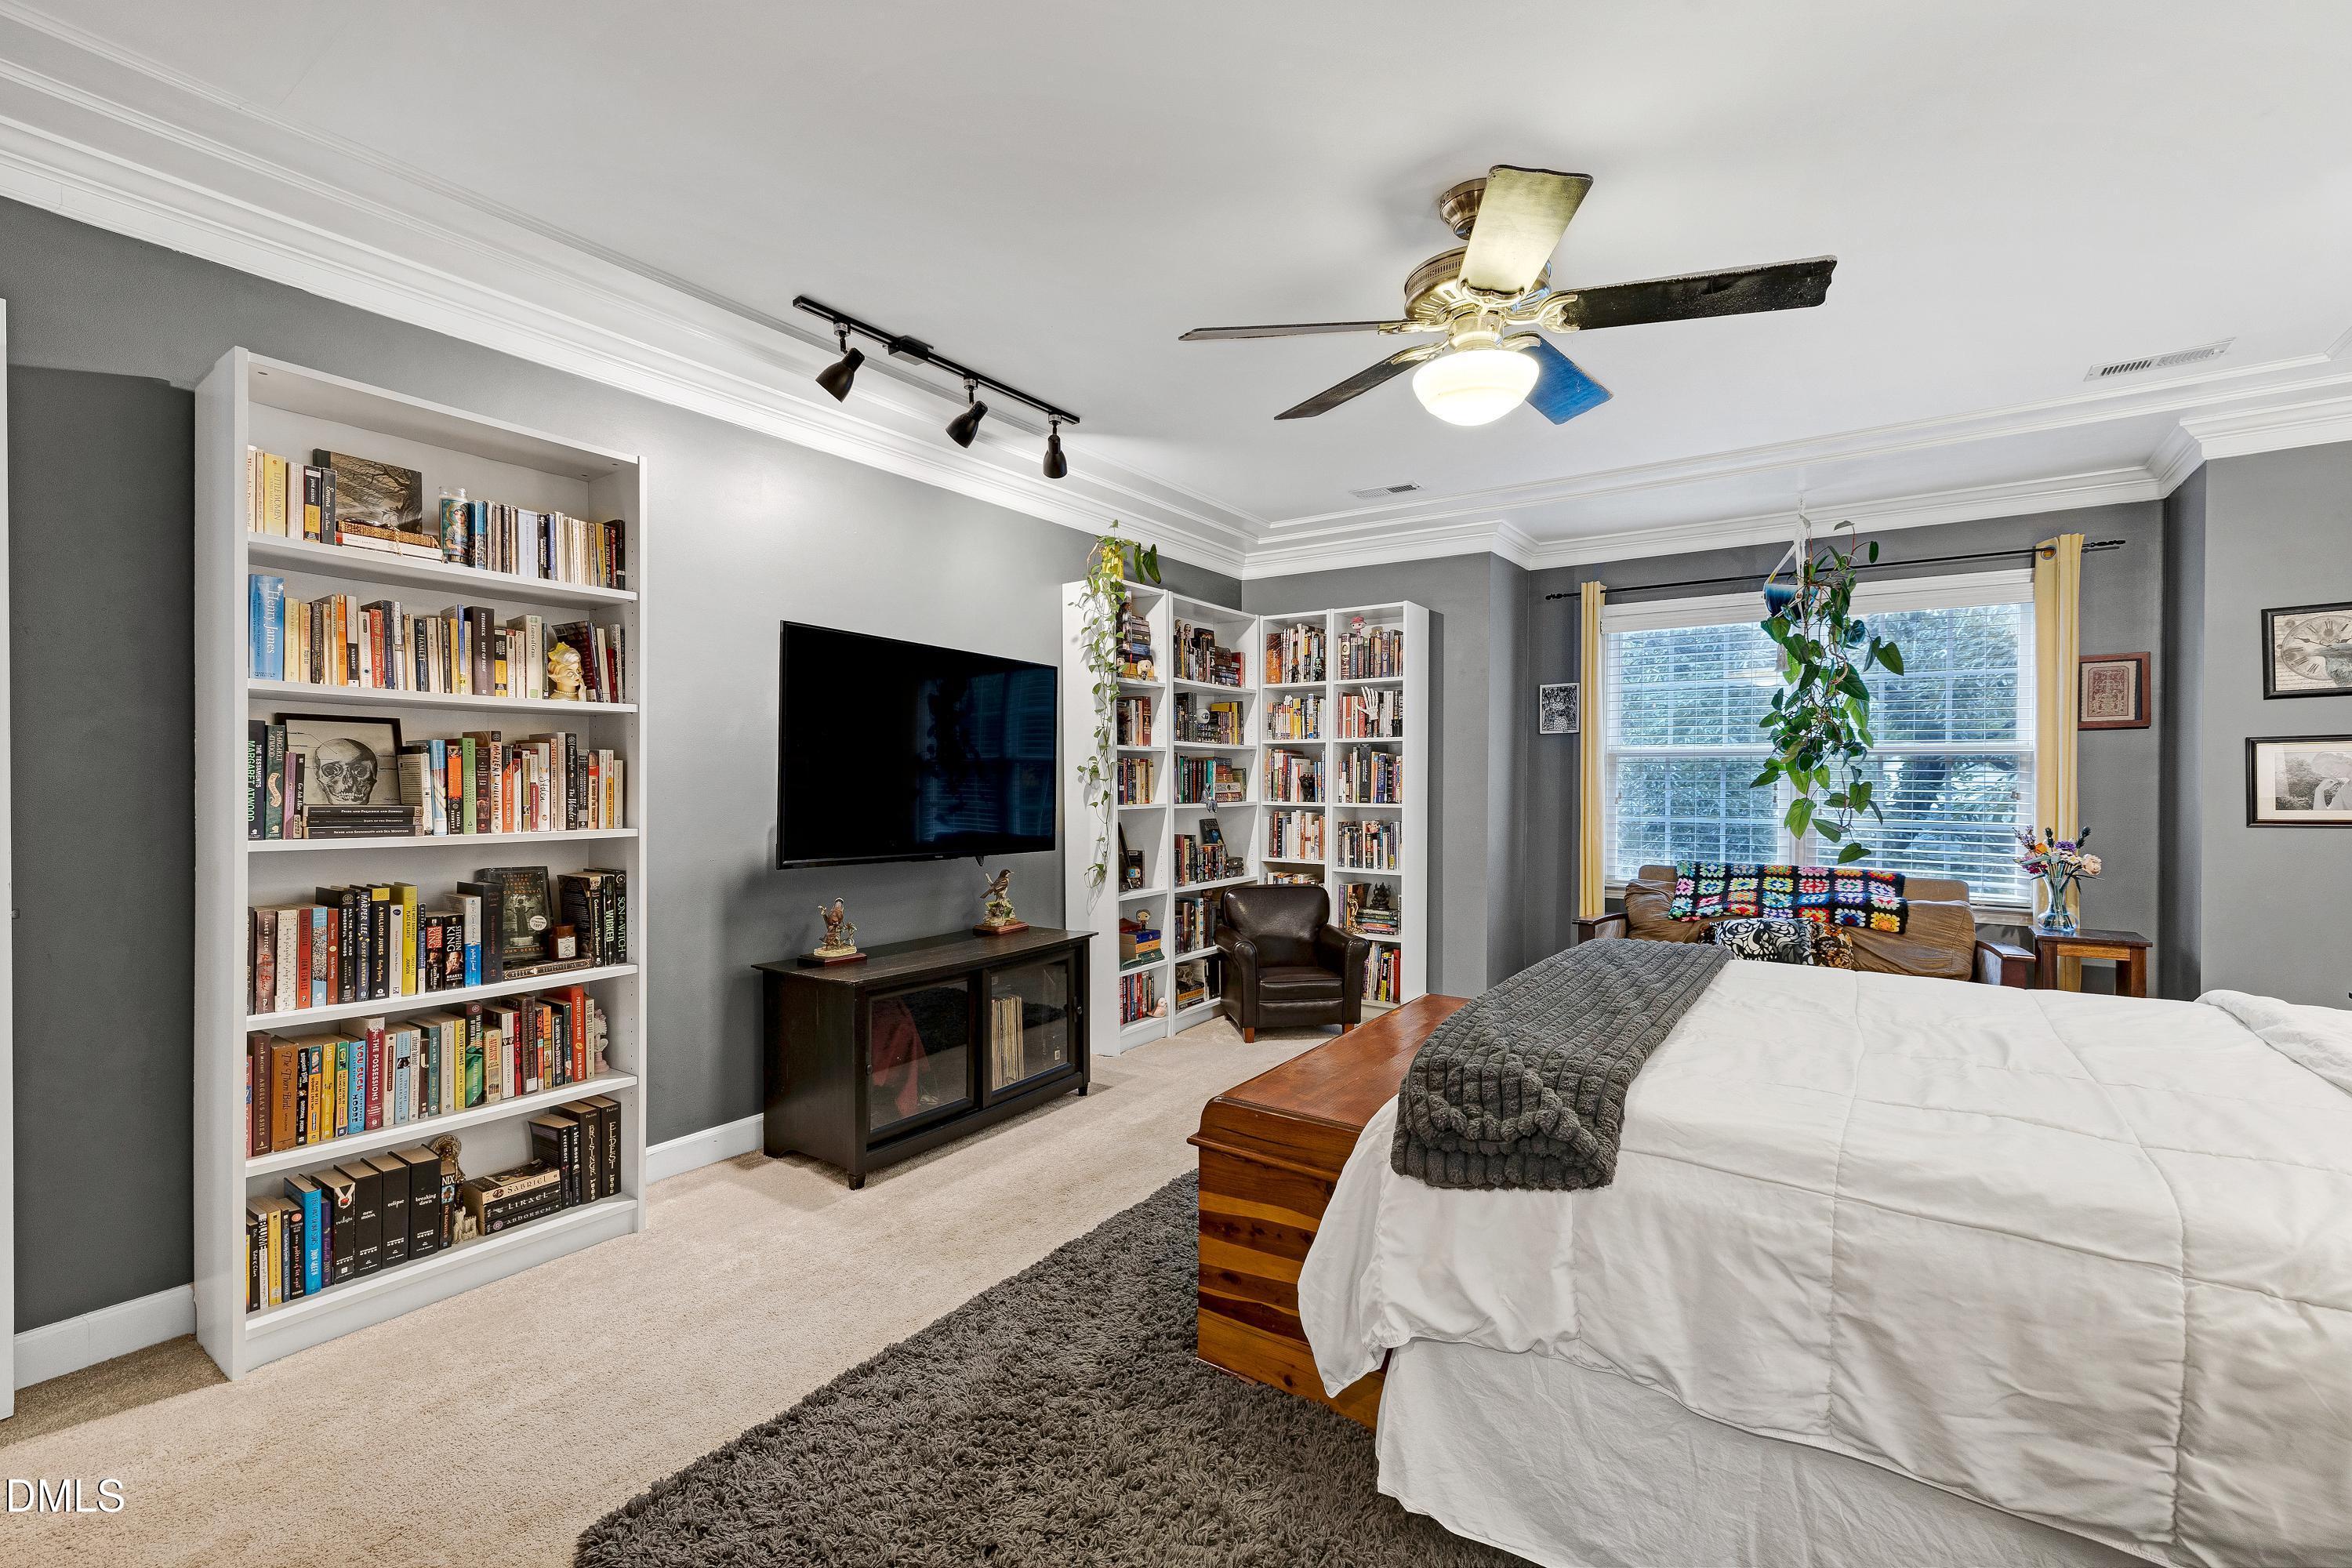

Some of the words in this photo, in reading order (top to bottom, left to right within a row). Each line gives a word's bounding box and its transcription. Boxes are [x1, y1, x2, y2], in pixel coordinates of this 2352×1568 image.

[325, 486, 334, 507] Emma
[264, 590, 279, 622] Henry
[263, 624, 278, 653] James
[539, 776, 549, 803] Stolen
[568, 798, 576, 821] Wonder
[447, 926, 456, 952] KING
[281, 1051, 292, 1066] The
[489, 1038, 498, 1062] AUGUST
[281, 1069, 292, 1091] Thorn
[282, 1093, 292, 1110] Birds
[442, 1175, 455, 1185] NIX
[507, 1176, 547, 1194] SABRIEL
[387, 1199, 405, 1209] eclipse
[416, 1193, 437, 1203] breaking
[508, 1192, 548, 1210] LIRAEL
[336, 1216, 353, 1225] twilight
[506, 1207, 551, 1225] ABHORSEN
